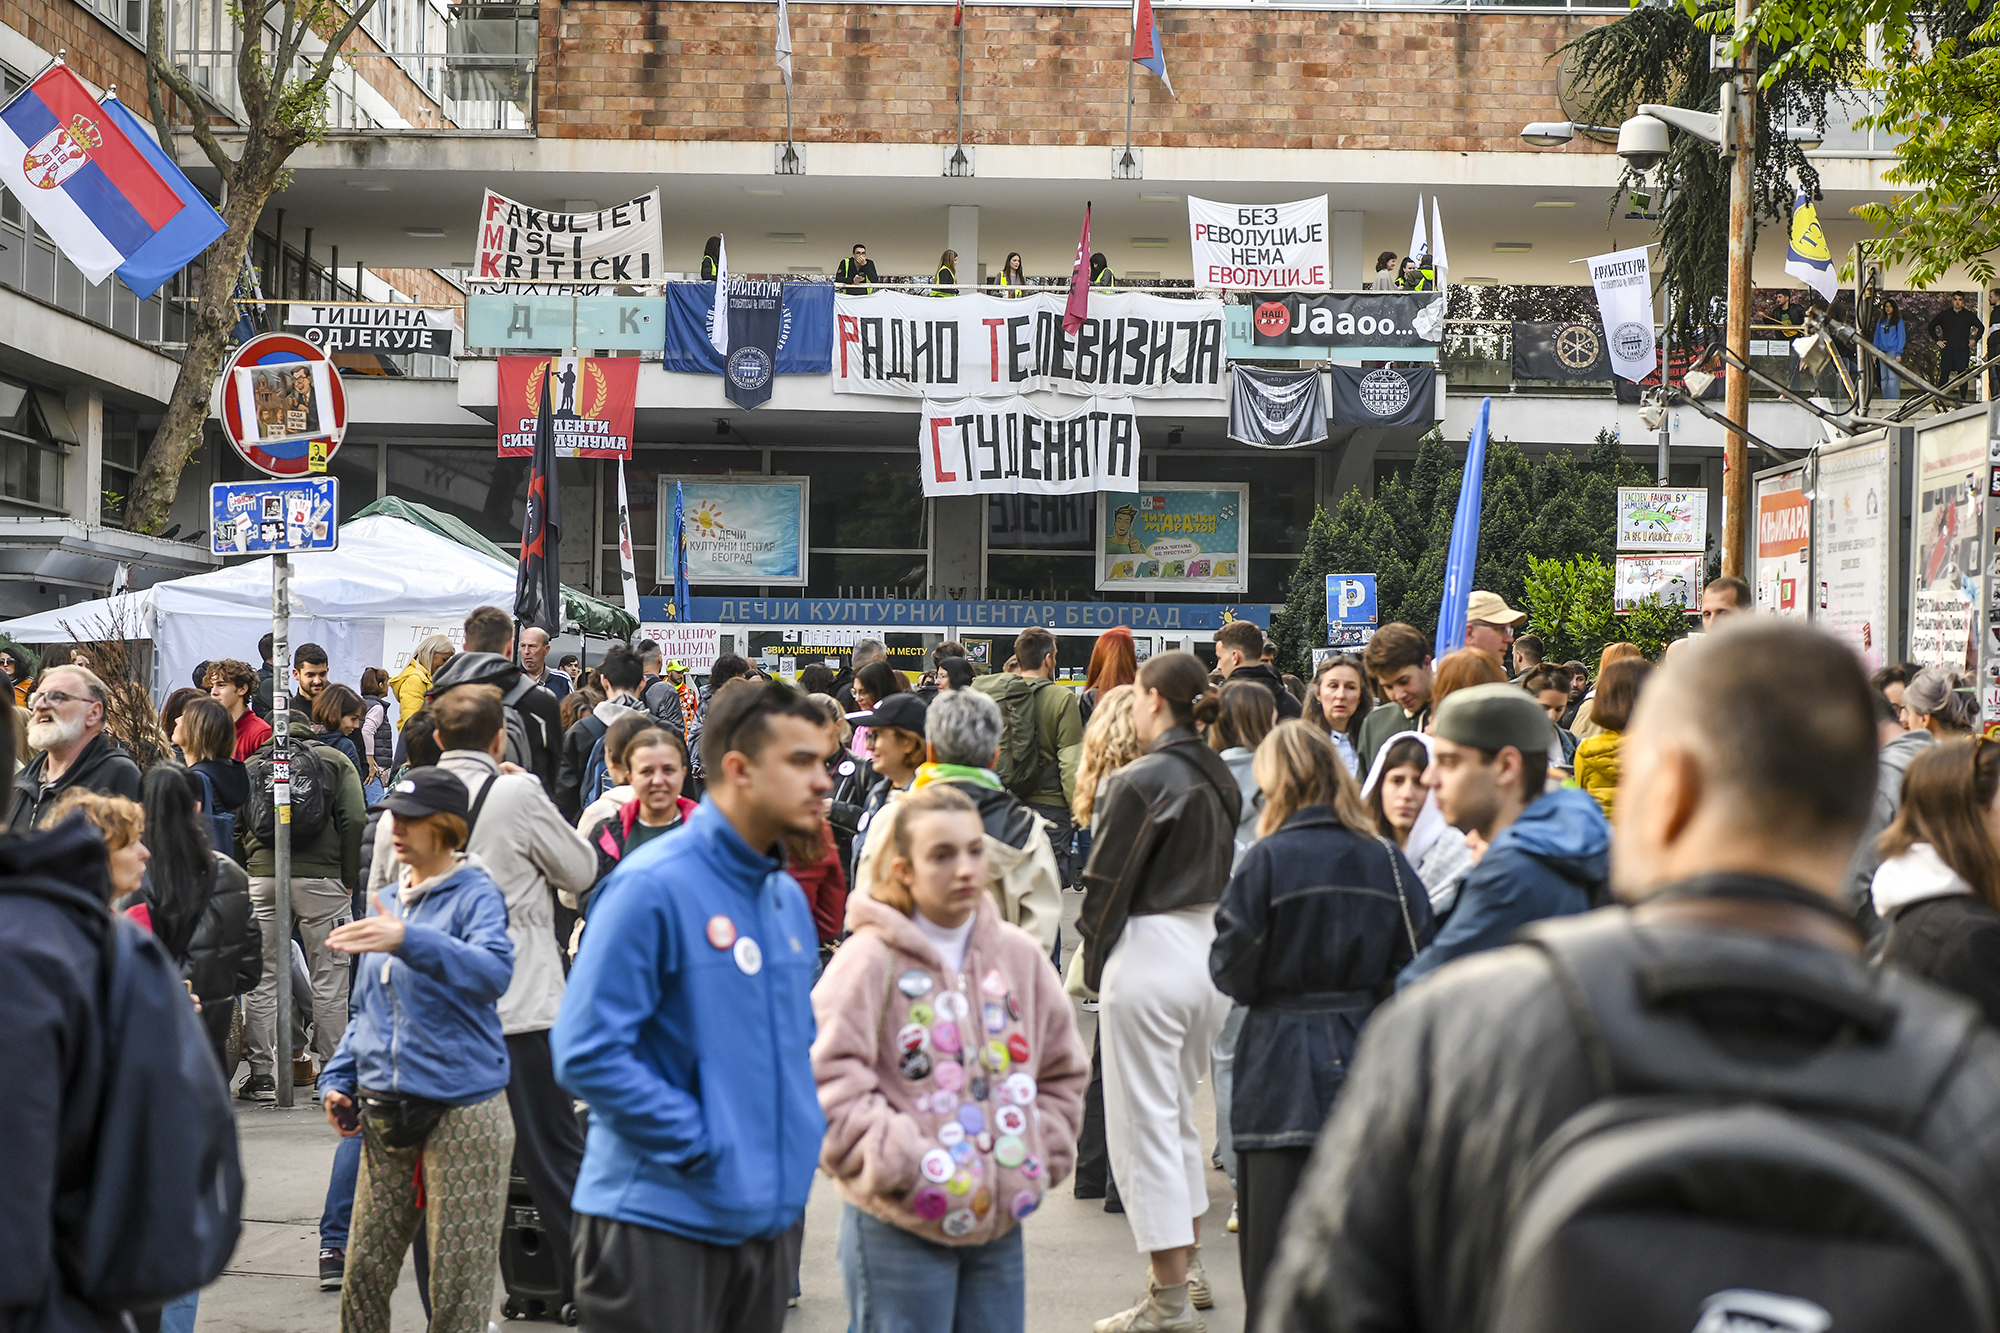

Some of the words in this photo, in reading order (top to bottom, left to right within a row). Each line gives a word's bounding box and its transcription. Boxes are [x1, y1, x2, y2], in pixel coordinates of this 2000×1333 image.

[486, 195, 652, 233] FAKULTET
[1237, 207, 1278, 226] БЕЗ
[482, 223, 583, 259] MISLI
[1195, 223, 1323, 247] РЕВОЛУЦИЈЕ
[479, 251, 650, 281] KRITIČKI
[1231, 247, 1285, 266] НЕМА
[1208, 265, 1325, 287] ЕВОЛУЦИЈЕ
[1594, 258, 1647, 281] АРХИТЕКТУРА
[311, 306, 428, 327] ТИШИНА
[1261, 310, 1284, 318] НАШ
[304, 327, 434, 351] ОДЈЕКУЈЕ
[837, 313, 959, 384] РАДИО
[982, 311, 1222, 386] ТЕЛЕВИЗИЈА
[519, 417, 611, 435] СТДЕНТИ
[501, 433, 628, 450] СИНДУНУМА
[930, 410, 1133, 483] СТУДЕНАТА
[718, 529, 747, 541] ДЕЧЈИ
[1144, 517, 1217, 533] МАРАТОН
[1760, 505, 1809, 544] КЊИЖАРА
[689, 541, 737, 551] КУЛТУРНИ
[740, 541, 776, 552] ЦЕНТАР
[711, 552, 753, 564] БЕОГРАД
[1338, 580, 1366, 618] P
[718, 600, 800, 622] ДЕЧЈИ
[810, 601, 945, 623] КУЛТУРНИ
[956, 603, 1055, 625] ЦЕНТАР
[1066, 604, 1181, 629] БЕОГРАД
[645, 628, 676, 641] ЗБОР
[677, 627, 717, 641] ЦЕНТАР
[658, 641, 716, 656] ЛИЛУЛА
[766, 645, 785, 655] СВИ
[786, 645, 840, 656] УЏБЕНИЦИ
[840, 647, 852, 655] НА
[897, 647, 928, 657] МЕСТУ
